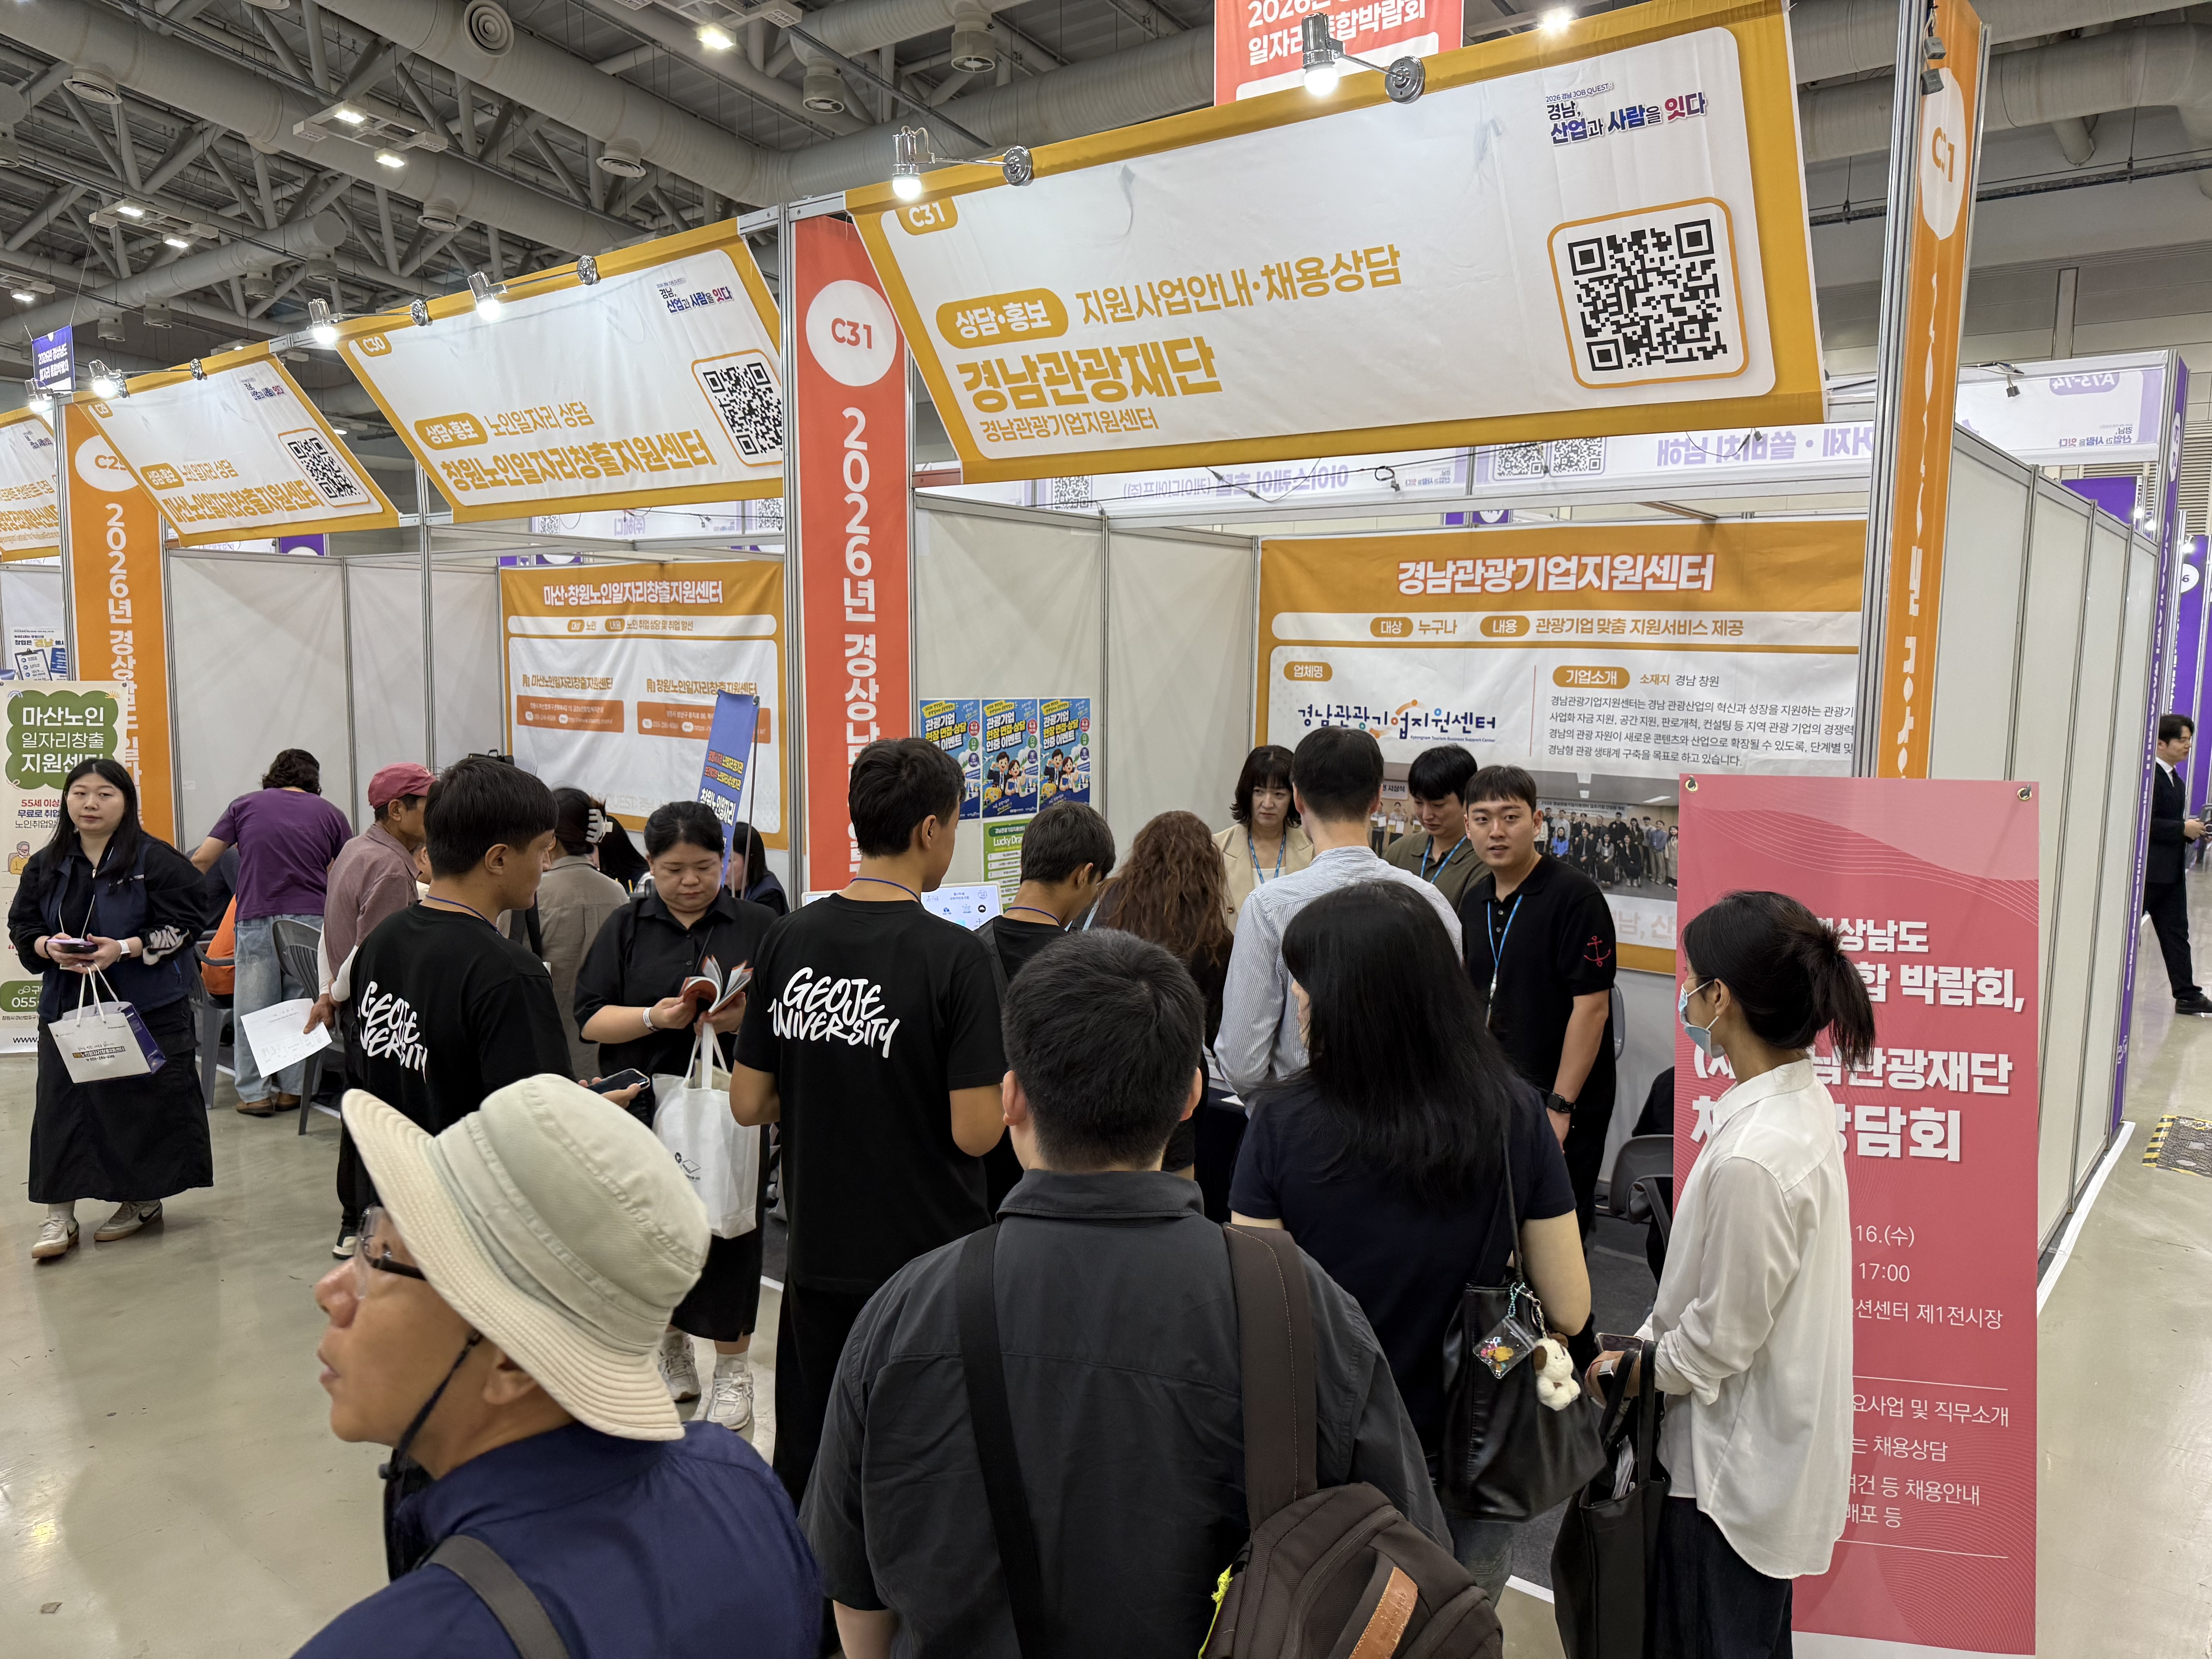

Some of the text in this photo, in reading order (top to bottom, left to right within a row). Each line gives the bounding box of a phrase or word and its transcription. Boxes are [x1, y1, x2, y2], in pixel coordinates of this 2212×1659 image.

[1546, 89, 1586, 102] 2026 경남 JOB
[1547, 101, 1581, 120] 경남,
[1551, 91, 1706, 145] 산업과 사람을 잇다
[908, 202, 945, 228] C31
[659, 287, 677, 299] 경남,
[1074, 244, 1402, 325] 지원사업안내·채용상담
[666, 286, 733, 313] 산업과 사람을 잇다
[955, 299, 1052, 339] 상담·홍보
[363, 336, 386, 352] C30
[831, 318, 872, 350] C31
[957, 336, 1223, 413] 경남관광재단
[95, 403, 109, 415] C29
[484, 401, 596, 437] 노인일자리 상담
[426, 422, 479, 445] 상담·홍보
[979, 407, 1159, 443] 경남관광기업지원센터
[214, 459, 239, 479] 상담
[440, 429, 718, 492] 창원노인일자리창출지원센터
[842, 407, 876, 623] 2026년
[106, 503, 132, 624] 2026년
[1398, 555, 1715, 594] 경남관광기업지원센터
[544, 580, 723, 606] 마산·창원노인일자리창출지원센터
[586, 621, 597, 630] 노인
[626, 621, 638, 629] 노인
[639, 620, 650, 629] 취업
[650, 621, 661, 630] 상담
[661, 621, 667, 630] 및
[668, 621, 680, 631] 취업
[1381, 617, 1744, 637] 대상 누구나 내용 관광기업 맞춤 지원서비스 제공
[531, 675, 613, 690] 마산노인일자리창출지원센터
[1293, 665, 1324, 678] 업체명
[1566, 670, 1719, 687] 기업소개 소재지 경남 창원
[22, 707, 105, 727] 마산노인
[1551, 696, 1646, 710] 경남관광기업지원센터는
[1648, 699, 1665, 710] 경남
[1667, 700, 1714, 713] 관광산업의
[1717, 702, 1747, 714] 혁신과
[1748, 704, 1779, 715] 성장을
[1781, 705, 1821, 716] 지원하는
[926, 712, 955, 732] 관광기업
[986, 711, 1015, 730] 관광기업
[1044, 710, 1069, 728] 관광기업
[1549, 712, 1575, 723] 사업화
[1577, 713, 1594, 724] 자금
[1596, 714, 1616, 725] 지원,
[1619, 715, 1638, 726] 공간
[1640, 716, 1659, 728] 지원,
[1661, 716, 1700, 730] 판로개척,
[1703, 719, 1732, 731] 컨설팅
[1734, 720, 1744, 732] 등
[1746, 721, 1766, 733] 지역
[1769, 722, 1789, 733] 관광
[1791, 723, 1821, 735] 기업의
[22, 732, 105, 749] 일자리창출
[941, 733, 963, 750] 이벤트
[1001, 731, 1022, 748] 이벤트
[1056, 729, 1075, 745] 이벤트
[1549, 728, 1574, 740] 경남의
[1576, 730, 1593, 740] 관광
[1595, 731, 1621, 742] 자원이
[1624, 732, 1652, 744] 새로운
[1653, 733, 1689, 745] 콘텐츠와
[1691, 735, 1728, 748] 산업으로
[1731, 738, 1760, 750] 확장될
[1762, 740, 1772, 750] 수
[1774, 740, 1807, 752] 있도록,
[1810, 742, 1841, 754] 단계별
[1548, 745, 1743, 767] 경남형 관광 생태계 구축을 목표로 하고 있습니다.
[18, 810, 43, 818] 무료로
[44, 799, 60, 807] 이상
[993, 835, 1023, 847] Lucky Dra
[783, 967, 886, 1026] GEOJE
[1900, 964, 2025, 1013] 박람회,
[1859, 1262, 1910, 1283] 17:00
[1916, 1304, 2003, 1329] 제1전시장
[1911, 1399, 1928, 1420] 및
[1934, 1401, 2009, 1427] 직무소개
[1873, 1435, 1948, 1462] 채용상담
[1881, 1477, 1980, 1506] 등 채용안내
[1883, 1506, 1903, 1528] 등
